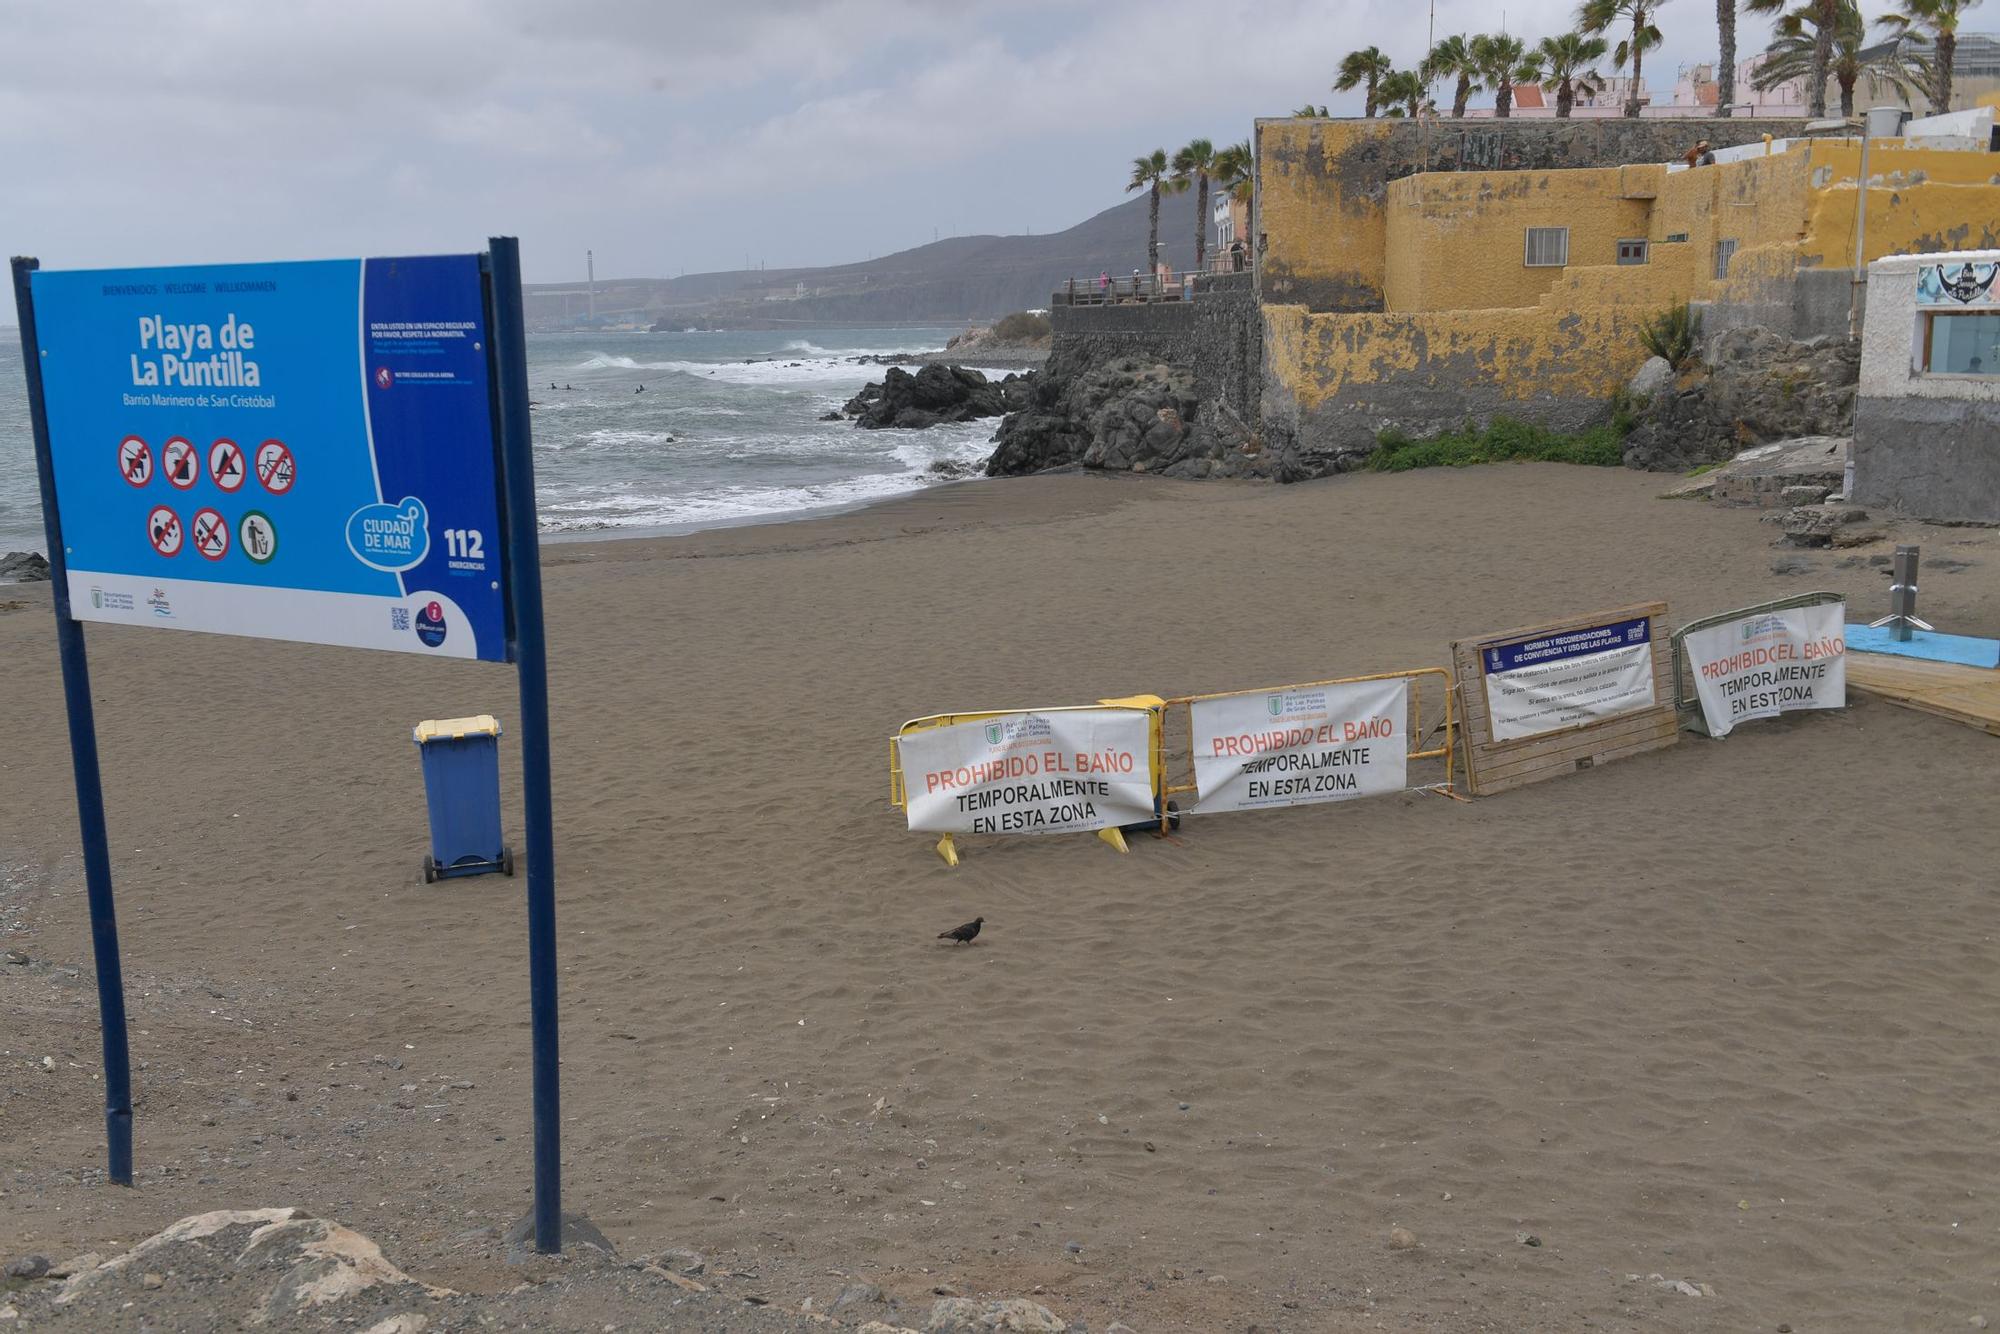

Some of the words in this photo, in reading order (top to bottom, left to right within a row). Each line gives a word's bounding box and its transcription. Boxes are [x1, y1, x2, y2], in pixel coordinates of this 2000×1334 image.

[102, 285, 157, 296] BIENVENIDOS
[164, 282, 206, 294] WELCOME
[214, 280, 276, 293] WILLKOMMEN
[139, 314, 212, 360] Playa
[220, 313, 254, 350] de
[131, 354, 158, 386] La
[162, 352, 260, 386] Puntilla
[123, 394, 150, 406] Barrio
[152, 394, 194, 406] Marinero
[196, 394, 208, 406] de
[211, 395, 228, 407] San
[230, 394, 275, 408] Cristóbal
[363, 519, 410, 535] CIUDAD
[364, 534, 381, 548] DE
[384, 534, 411, 550] MAR
[444, 529, 484, 558] 112
[448, 560, 485, 570] EMERGENCIAS
[1514, 654, 1523, 662] DE
[1524, 647, 1563, 660] CONVIVENCIA
[1568, 644, 1580, 652] USO
[1580, 642, 1589, 650] DE
[1589, 639, 1600, 648] LAS
[1601, 636, 1622, 645] PLAYAS
[1524, 640, 1550, 652] NORMAS
[1556, 629, 1612, 646] RECOMENDACIONES
[1777, 644, 1798, 660] EL
[1804, 637, 1844, 660] BAÑO
[1732, 698, 1746, 714] EN
[1750, 692, 1780, 709] EST
[1213, 728, 1314, 757] PROHIBIDO
[1317, 725, 1339, 743] EL
[1344, 716, 1392, 744] BAÑO
[926, 754, 1038, 794] PROHIBIDO
[1044, 752, 1070, 773] EL
[1076, 748, 1134, 773] BAÑO
[1240, 748, 1370, 775] TEMPORALMENTE
[957, 780, 1109, 812] TEMPORALMENTE
[1249, 781, 1269, 798] EN
[1274, 777, 1311, 796] ESTA
[1315, 774, 1357, 792] ZONA
[973, 815, 996, 834] EN
[1002, 809, 1046, 831] ESTA
[1050, 801, 1096, 824] ZONA
